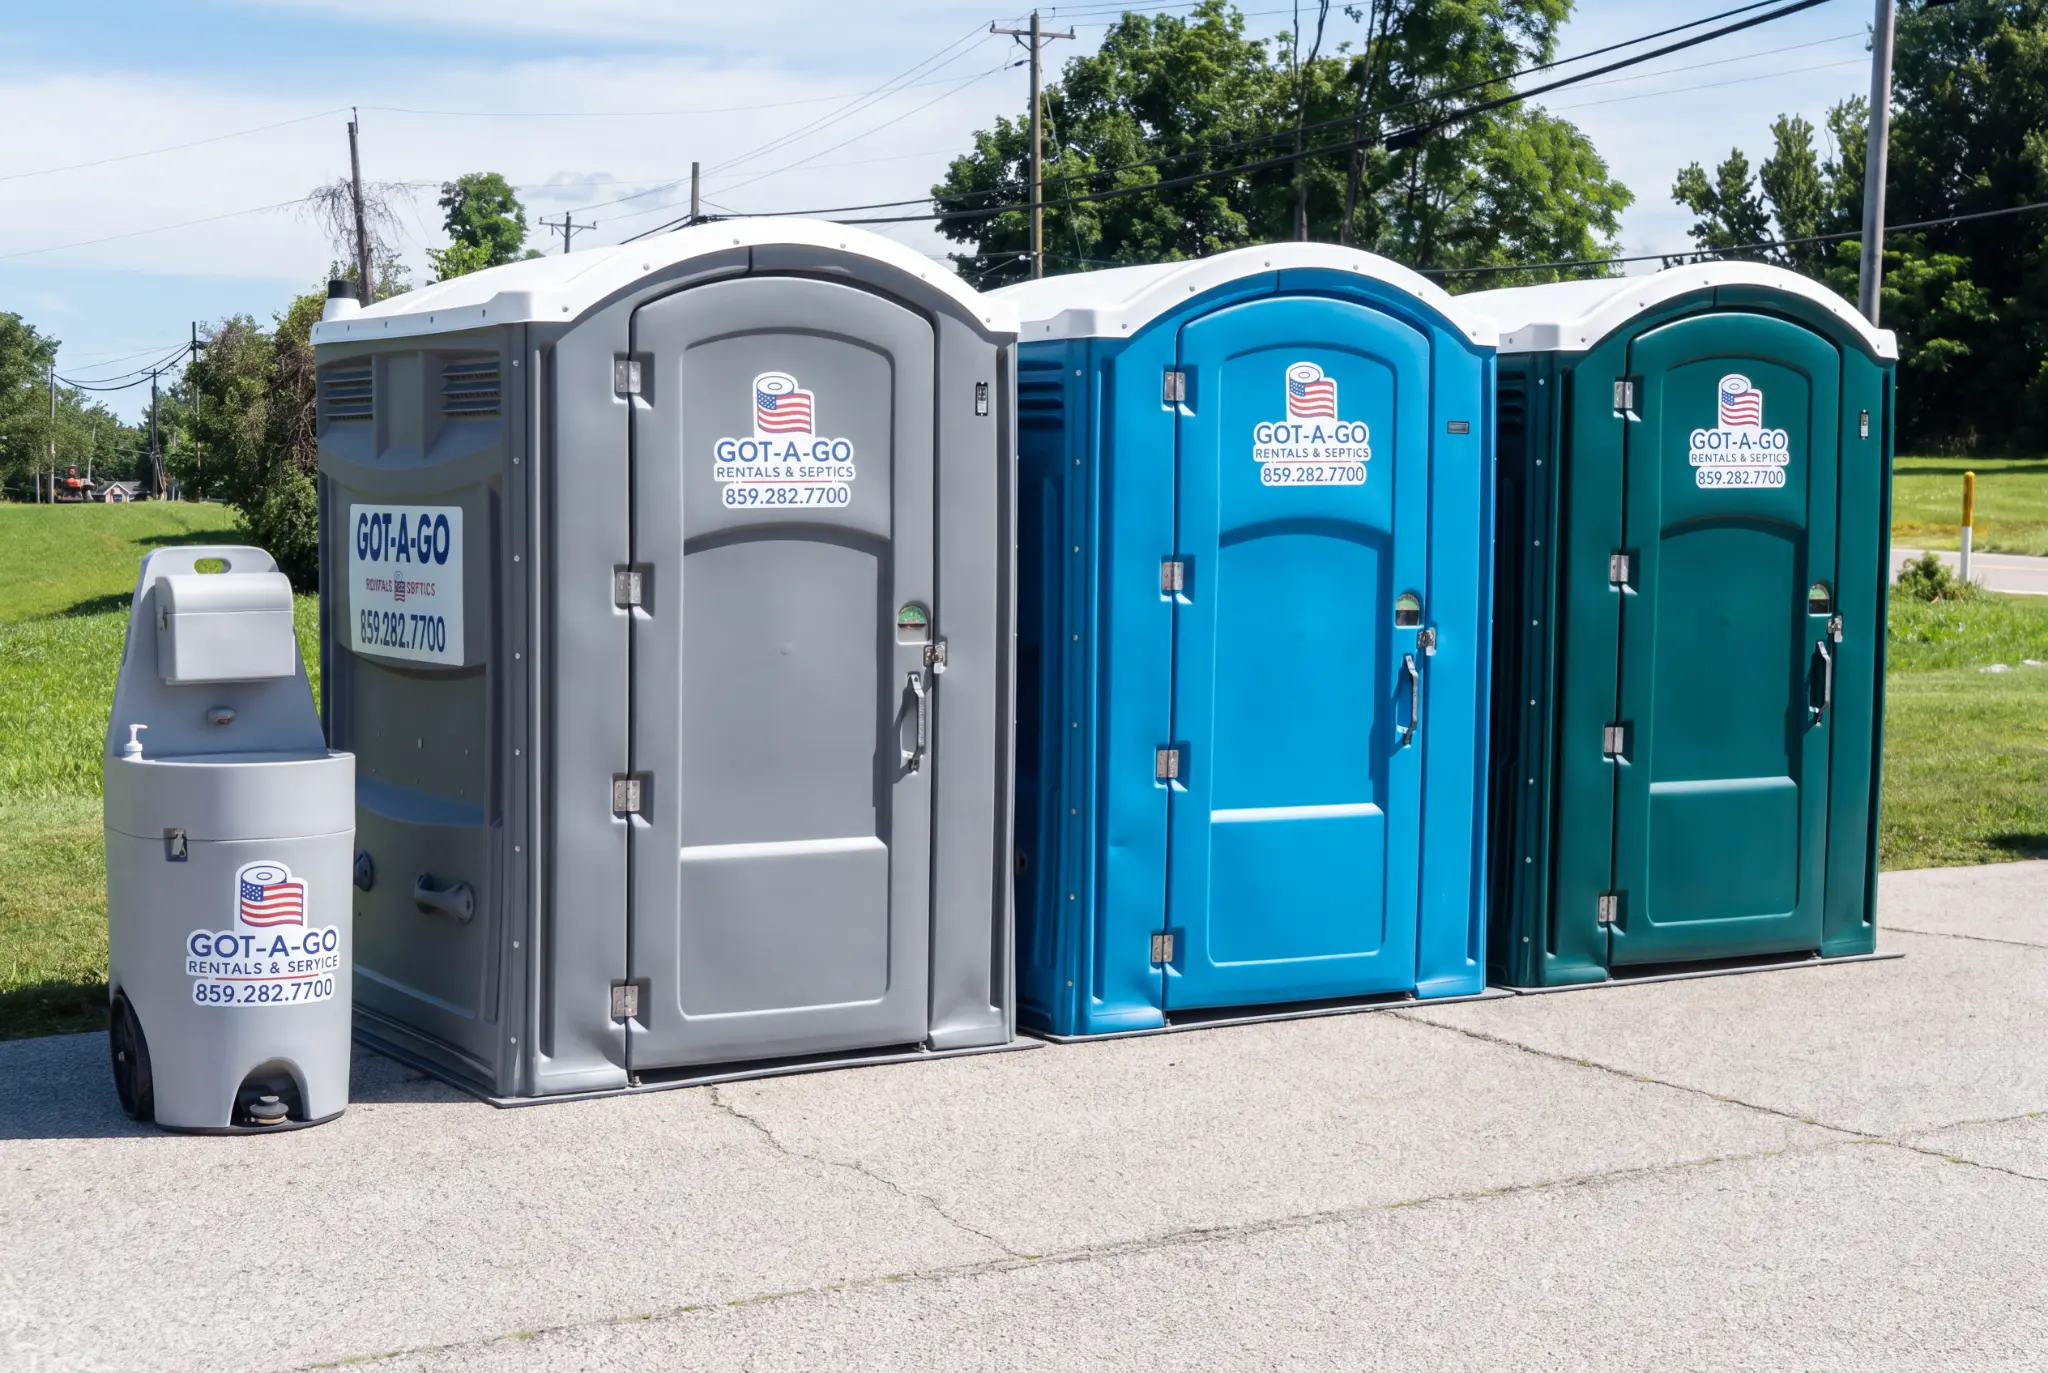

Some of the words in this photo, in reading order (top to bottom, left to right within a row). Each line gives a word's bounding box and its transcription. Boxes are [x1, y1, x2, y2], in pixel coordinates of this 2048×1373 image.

[1256, 424, 1367, 444] GOT-A-GO
[1692, 432, 1786, 450] GOT-A-GO
[717, 440, 851, 463] GOT-A-GO
[1255, 448, 1309, 459] RENTALS
[1312, 447, 1321, 458] &
[1324, 447, 1370, 458] SEPTICS
[1691, 453, 1737, 463] RENTALS
[1740, 453, 1747, 463] &
[1750, 453, 1788, 463] SEPTICS
[716, 466, 780, 478] RENTALS
[785, 466, 794, 478] &
[799, 466, 854, 478] SEPTICS
[1263, 466, 1365, 483] 859.282.7700
[1698, 470, 1784, 485] 859.282.7700
[725, 487, 848, 505] 859.282.7700
[357, 512, 450, 566] GOT-A-GO
[360, 609, 446, 653] 859.282.7700
[190, 929, 337, 958] GOT-A-GO
[188, 960, 262, 975] RENTALS
[270, 961, 280, 974] &
[195, 978, 333, 1004] 859.282.7700
